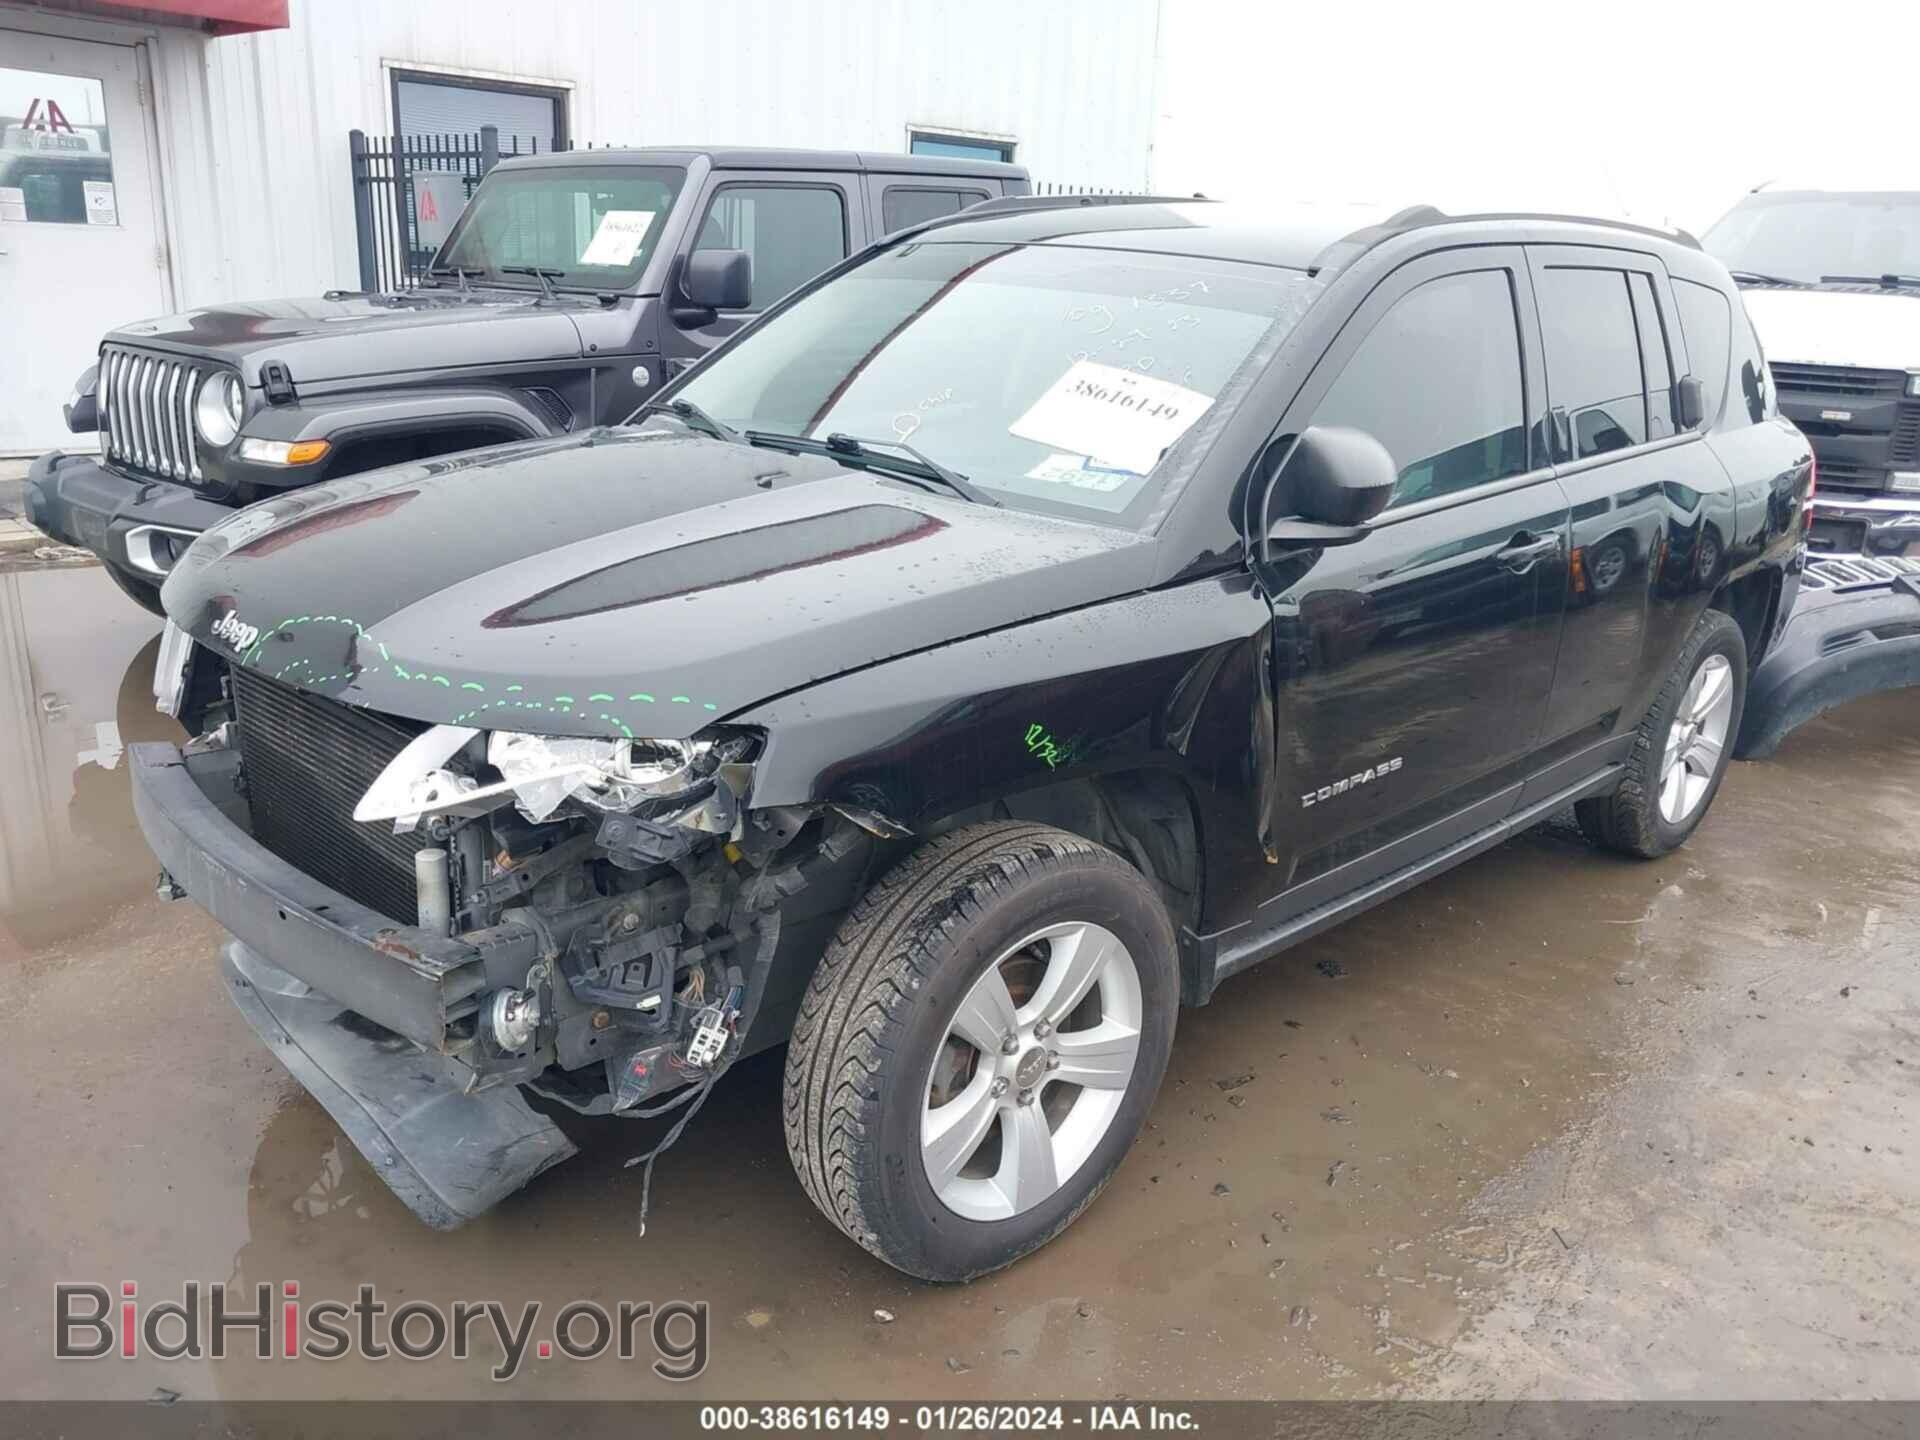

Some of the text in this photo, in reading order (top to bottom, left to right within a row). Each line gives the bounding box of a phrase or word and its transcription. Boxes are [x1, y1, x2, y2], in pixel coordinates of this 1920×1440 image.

[1066, 380, 1179, 420] 38616149
[211, 609, 259, 653] Jeep
[1301, 756, 1404, 808] COMPASS
